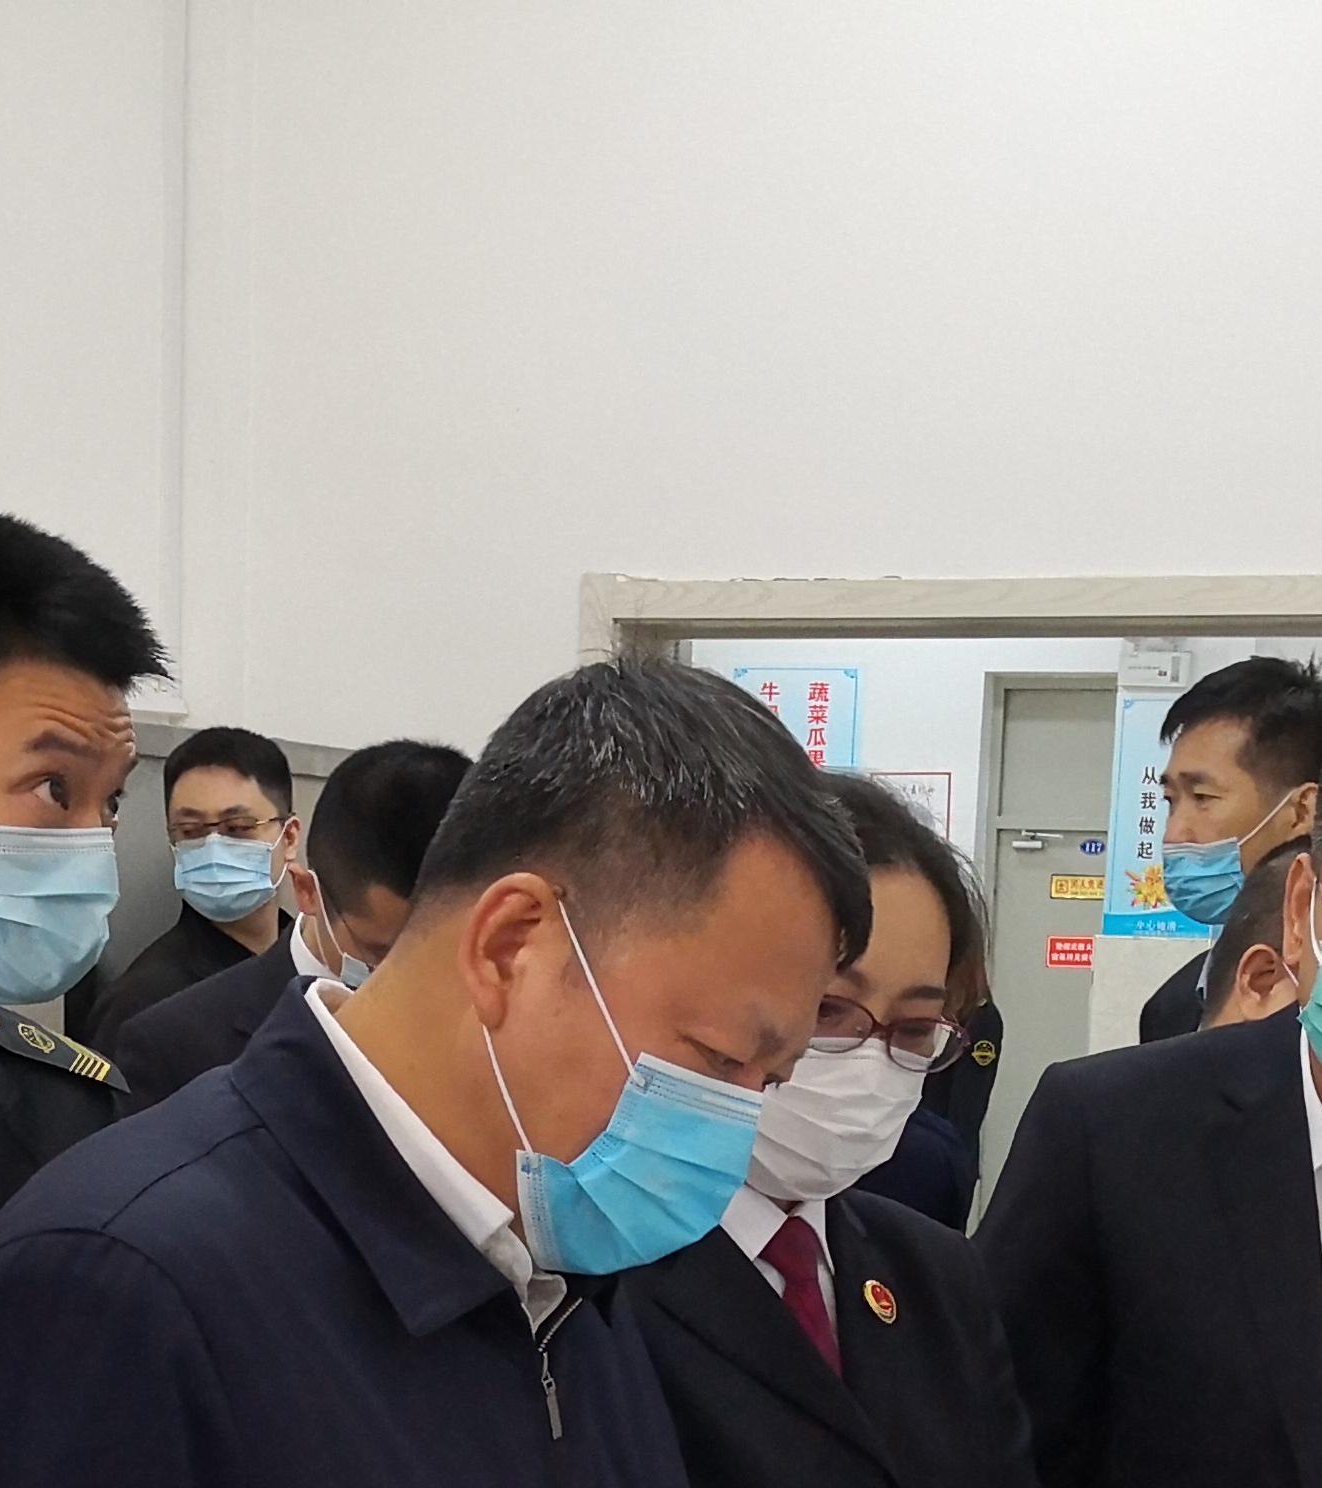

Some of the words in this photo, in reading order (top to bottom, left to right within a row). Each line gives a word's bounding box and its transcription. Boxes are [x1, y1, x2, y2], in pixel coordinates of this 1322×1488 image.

[806, 682, 830, 767] 蔬菜瓜果
[1136, 766, 1159, 859] 从我做起
